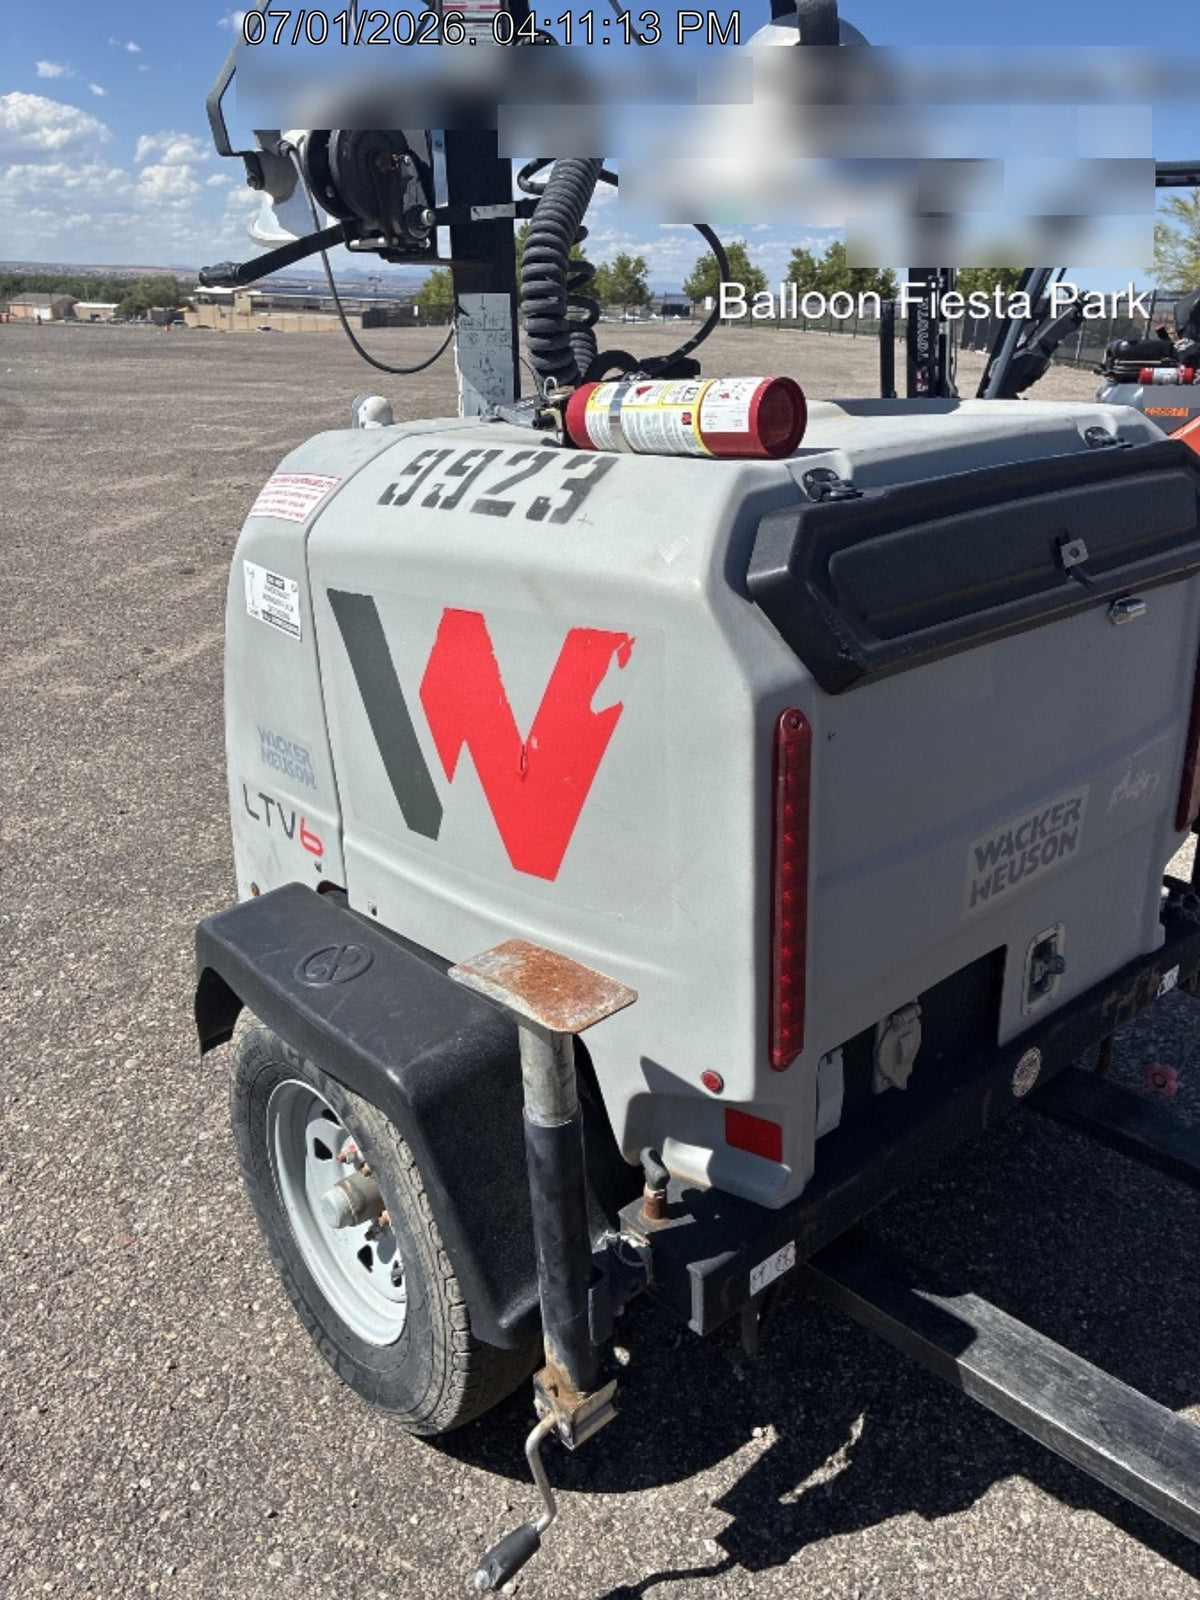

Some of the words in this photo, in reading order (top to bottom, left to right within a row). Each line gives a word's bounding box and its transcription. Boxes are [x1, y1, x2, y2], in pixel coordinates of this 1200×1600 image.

[377, 449, 620, 525] 9923
[243, 783, 324, 857] LTV6
[974, 797, 1082, 872] WACKER
[970, 827, 1078, 908] NEUSON
